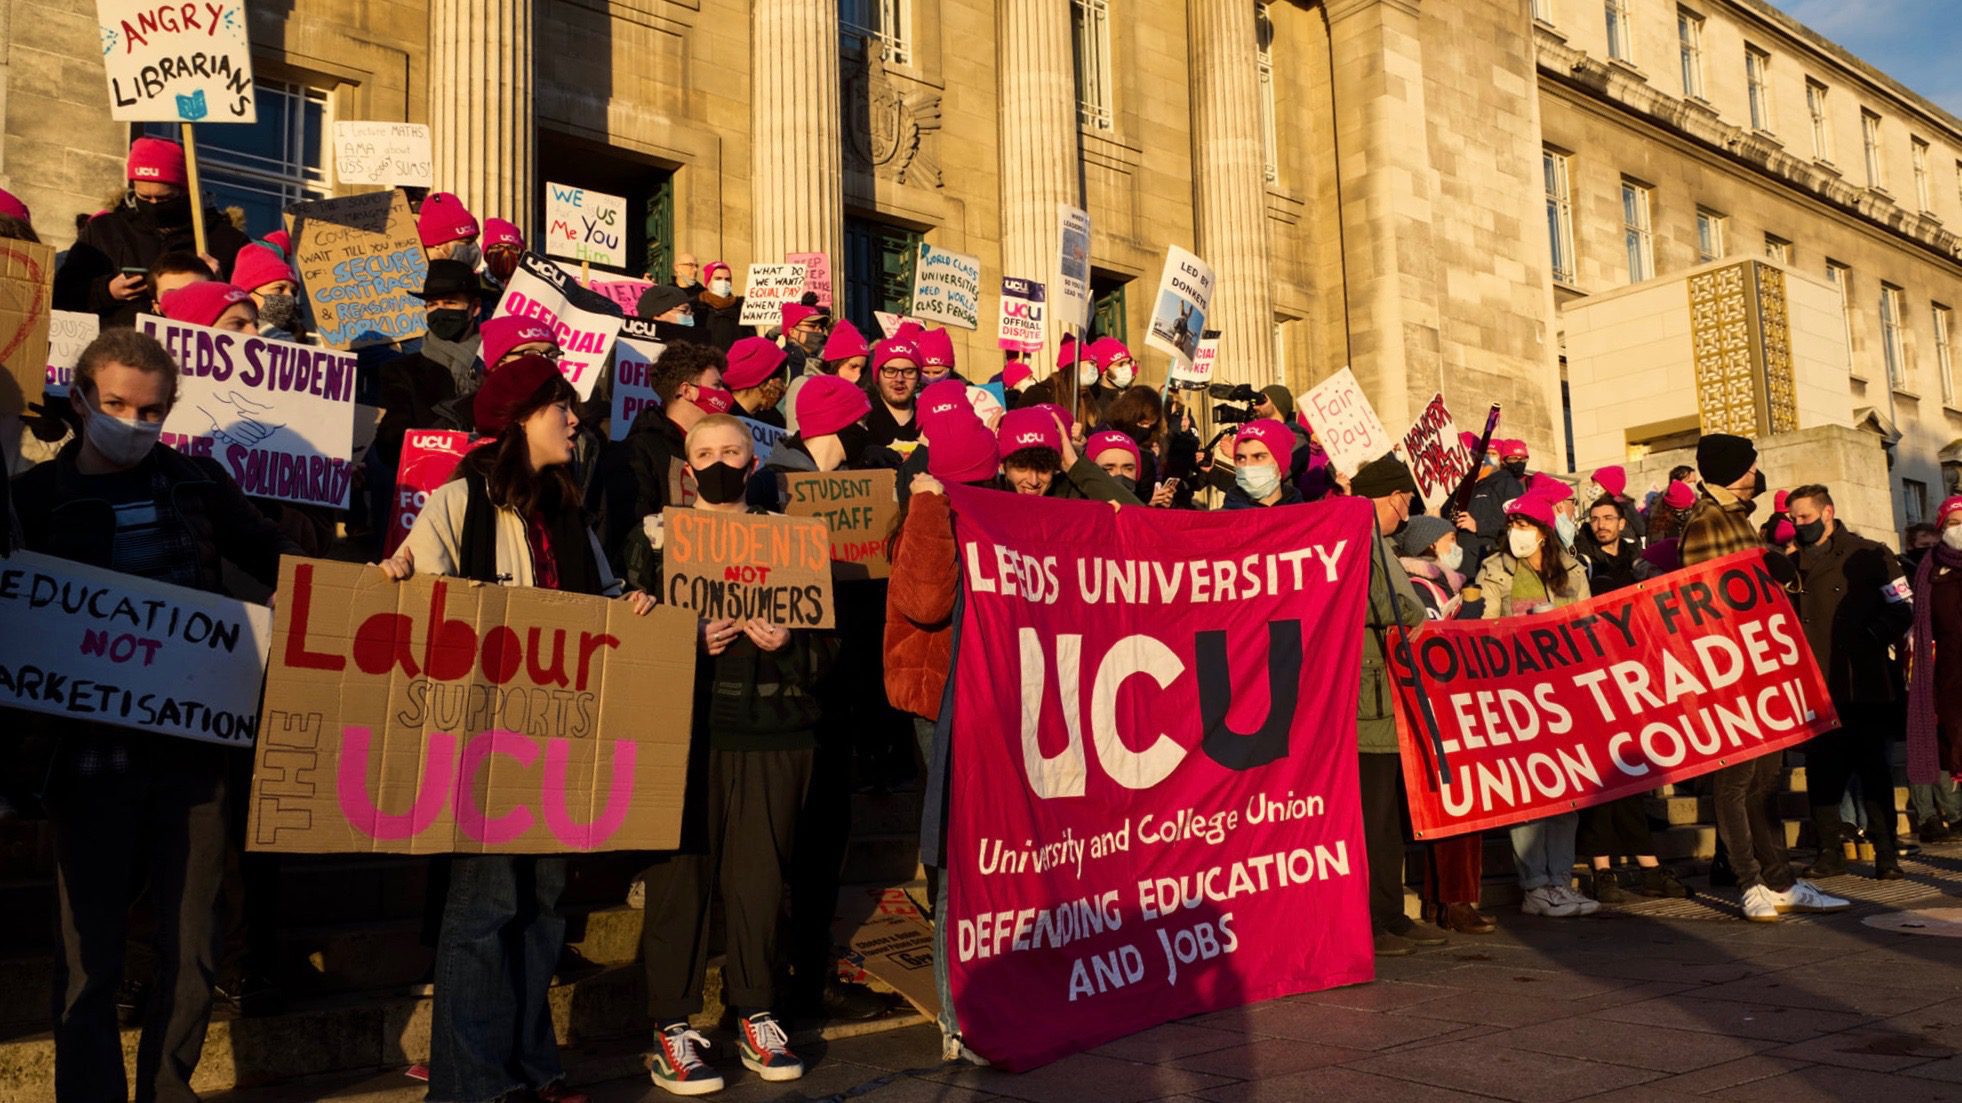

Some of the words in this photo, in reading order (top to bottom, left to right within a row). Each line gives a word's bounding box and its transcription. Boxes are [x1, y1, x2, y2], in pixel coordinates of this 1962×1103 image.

[120, 2, 226, 55] ANGRY
[112, 52, 253, 118] LIBRARIANS
[135, 167, 159, 177] UCU
[395, 160, 431, 178] SUMS!
[552, 184, 584, 208] WE
[596, 204, 617, 226] US
[550, 219, 577, 241] Me
[299, 249, 334, 264] WAIT
[341, 244, 367, 257] TILL
[370, 241, 389, 254] YOU
[332, 247, 426, 283] SECURE
[526, 256, 567, 288] UCU
[753, 266, 784, 276] WHAT
[791, 266, 804, 276] DO
[926, 254, 951, 267] WORLD
[953, 258, 979, 281] CLASS
[1180, 261, 1199, 278] LED
[1199, 274, 1210, 288] BY
[749, 287, 780, 299] EQUAL
[783, 286, 801, 298] PAY
[755, 278, 770, 287] WE
[775, 276, 805, 286] WANT?
[919, 285, 941, 297] NEED
[921, 271, 980, 302] UNIVERSITIES
[1004, 279, 1029, 291] UCU
[1171, 276, 1207, 311] DONKEYS
[321, 308, 333, 321] &
[743, 311, 770, 321] WANT
[746, 300, 775, 310] WHEN
[916, 299, 944, 315] CLASS
[1004, 301, 1042, 321] UCU
[518, 327, 550, 340] UCU
[622, 319, 656, 338] UCU
[1002, 326, 1041, 339] DISPUTE
[1003, 317, 1042, 331] OFFICIAL
[889, 345, 912, 354] UCU
[1195, 347, 1215, 360] CIAL
[240, 338, 358, 402] STUDENT
[1312, 388, 1354, 424] Fair
[412, 435, 453, 449] UCU
[1016, 433, 1045, 445] UCU
[1241, 426, 1265, 437] UCU
[1327, 404, 1376, 455] Pay!
[226, 443, 352, 506] SOLIDARITY
[794, 478, 872, 504] STUDENT
[812, 506, 873, 533] TAFF
[672, 513, 828, 572] STUDENTS
[724, 566, 772, 585] NOT
[965, 541, 1060, 605] LEEDS
[1076, 539, 1348, 605] UNIVERSITY
[0, 569, 241, 654] EDUCATION
[670, 572, 823, 626] CONSUMERS
[284, 563, 621, 692] Labour
[80, 628, 163, 667] NOT
[1394, 604, 1638, 688] SOLIDARITY
[1427, 682, 1574, 756] LEEDS
[1572, 613, 1800, 723] TRADES
[0, 664, 254, 741] ARKETISATION
[397, 679, 595, 738] SUPPORTS
[1017, 618, 1304, 799] UCU
[1437, 743, 1605, 818] UNION
[1608, 677, 1816, 778] COUNCIL
[256, 709, 323, 845] THE
[336, 725, 638, 851] UCU
[978, 827, 1085, 880] University
[1090, 819, 1130, 859] and
[1137, 808, 1238, 847] College
[1245, 790, 1325, 825] Union
[957, 889, 1121, 963] DEFENDING
[1137, 840, 1351, 922] EDUCATION
[1068, 943, 1145, 1002] AND
[1156, 911, 1239, 986] JOBS
